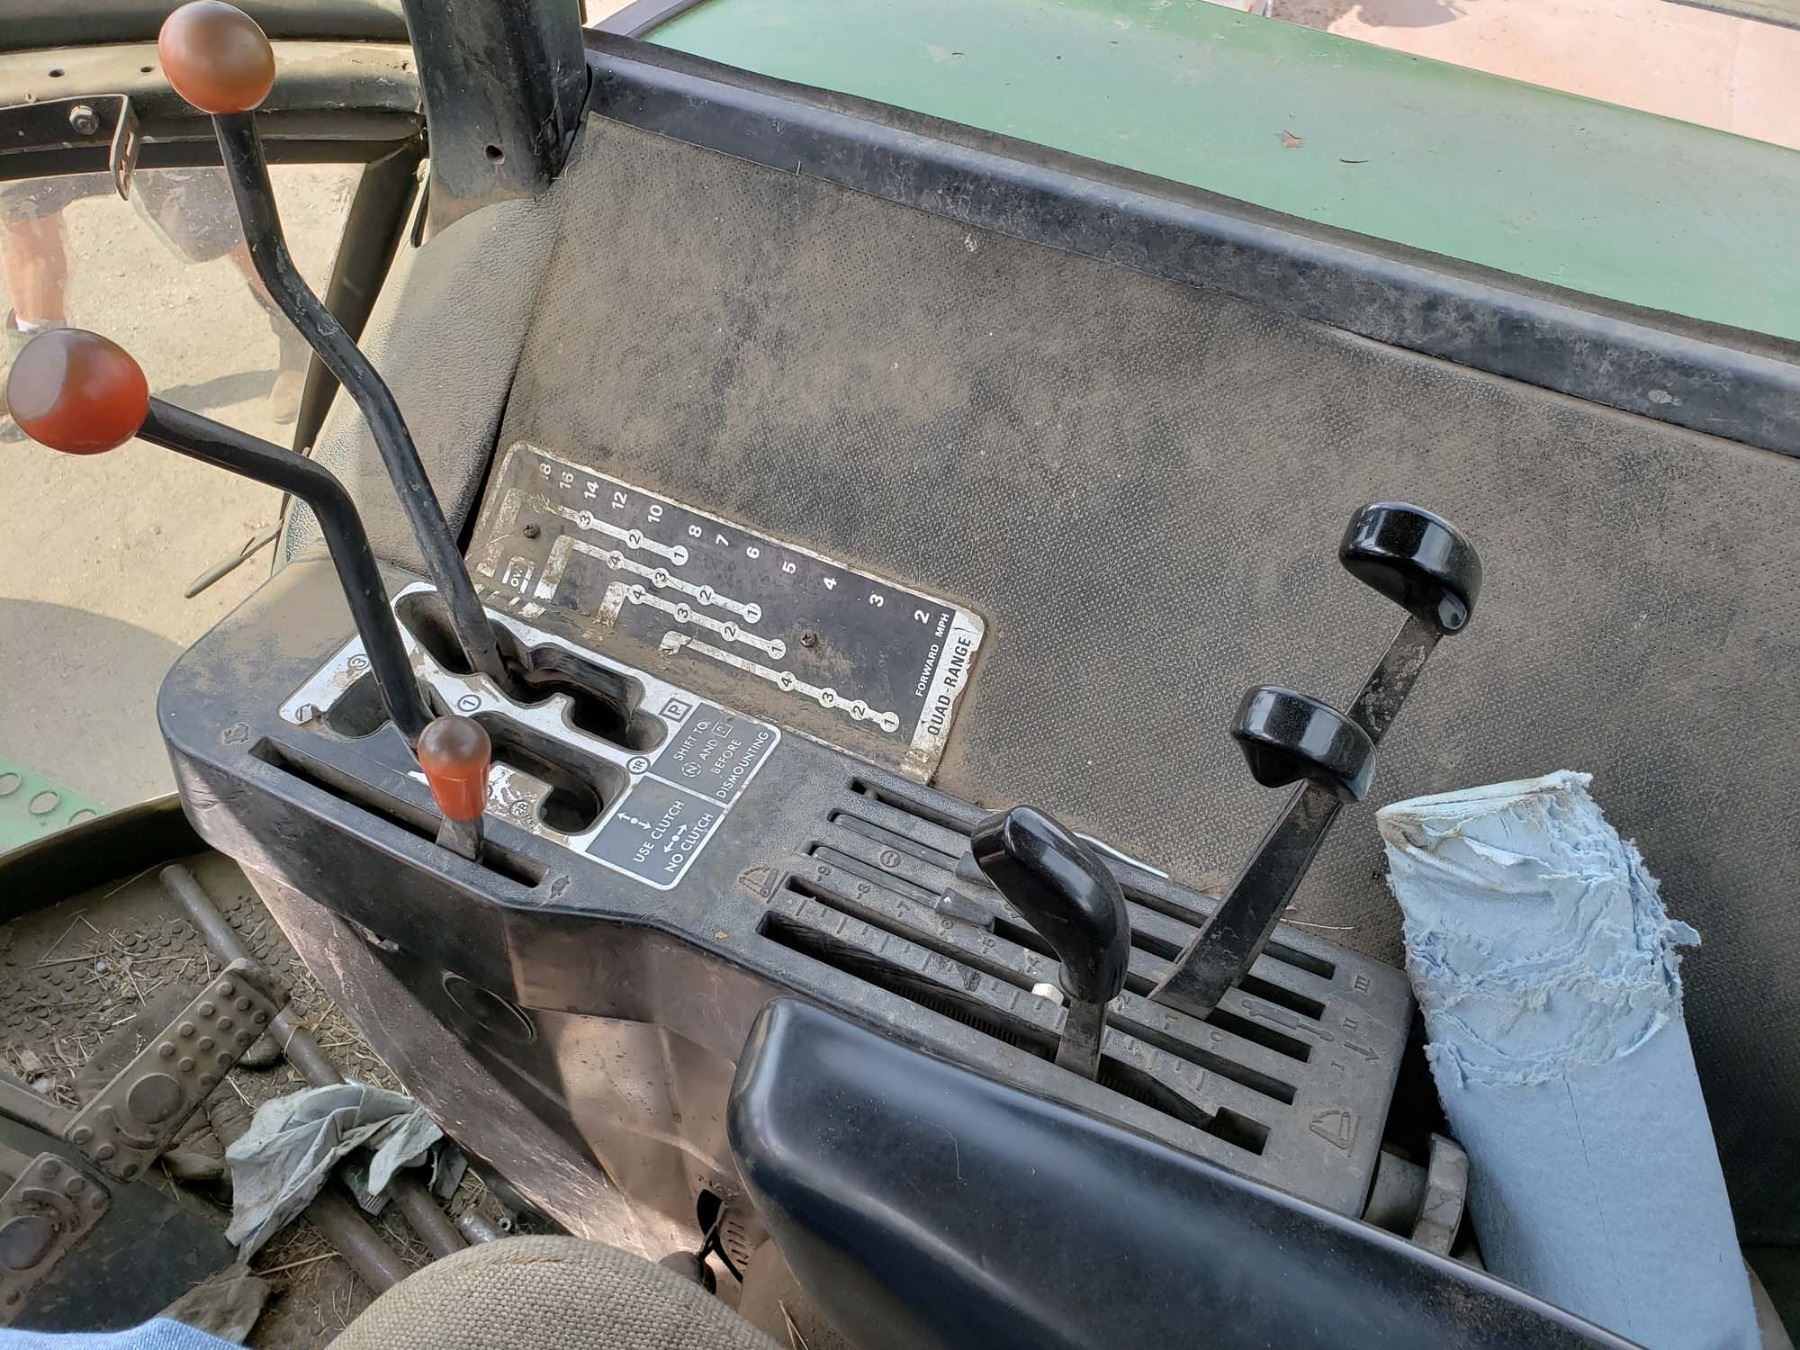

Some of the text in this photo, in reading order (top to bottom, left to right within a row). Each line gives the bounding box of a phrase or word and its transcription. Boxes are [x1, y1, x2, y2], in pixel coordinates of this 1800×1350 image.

[560, 471, 574, 489] 16
[584, 481, 600, 499] 14
[612, 491, 628, 510] 12
[648, 504, 663, 523] 10
[688, 525, 702, 538] 8
[715, 534, 729, 547] 7
[746, 546, 760, 559] 6
[782, 561, 797, 574] 5
[823, 577, 837, 591] 4
[869, 593, 884, 607] 3
[914, 610, 930, 624] 2
[915, 613, 950, 697] FORWARD MPH
[673, 720, 709, 761] SHIFT TO
[699, 739, 718, 761] AND
[710, 739, 742, 775] BEFORE
[716, 731, 769, 799] DISMOUNTING
[633, 800, 685, 863] USE CLUTCH
[664, 813, 714, 873] NO CLUTCH
